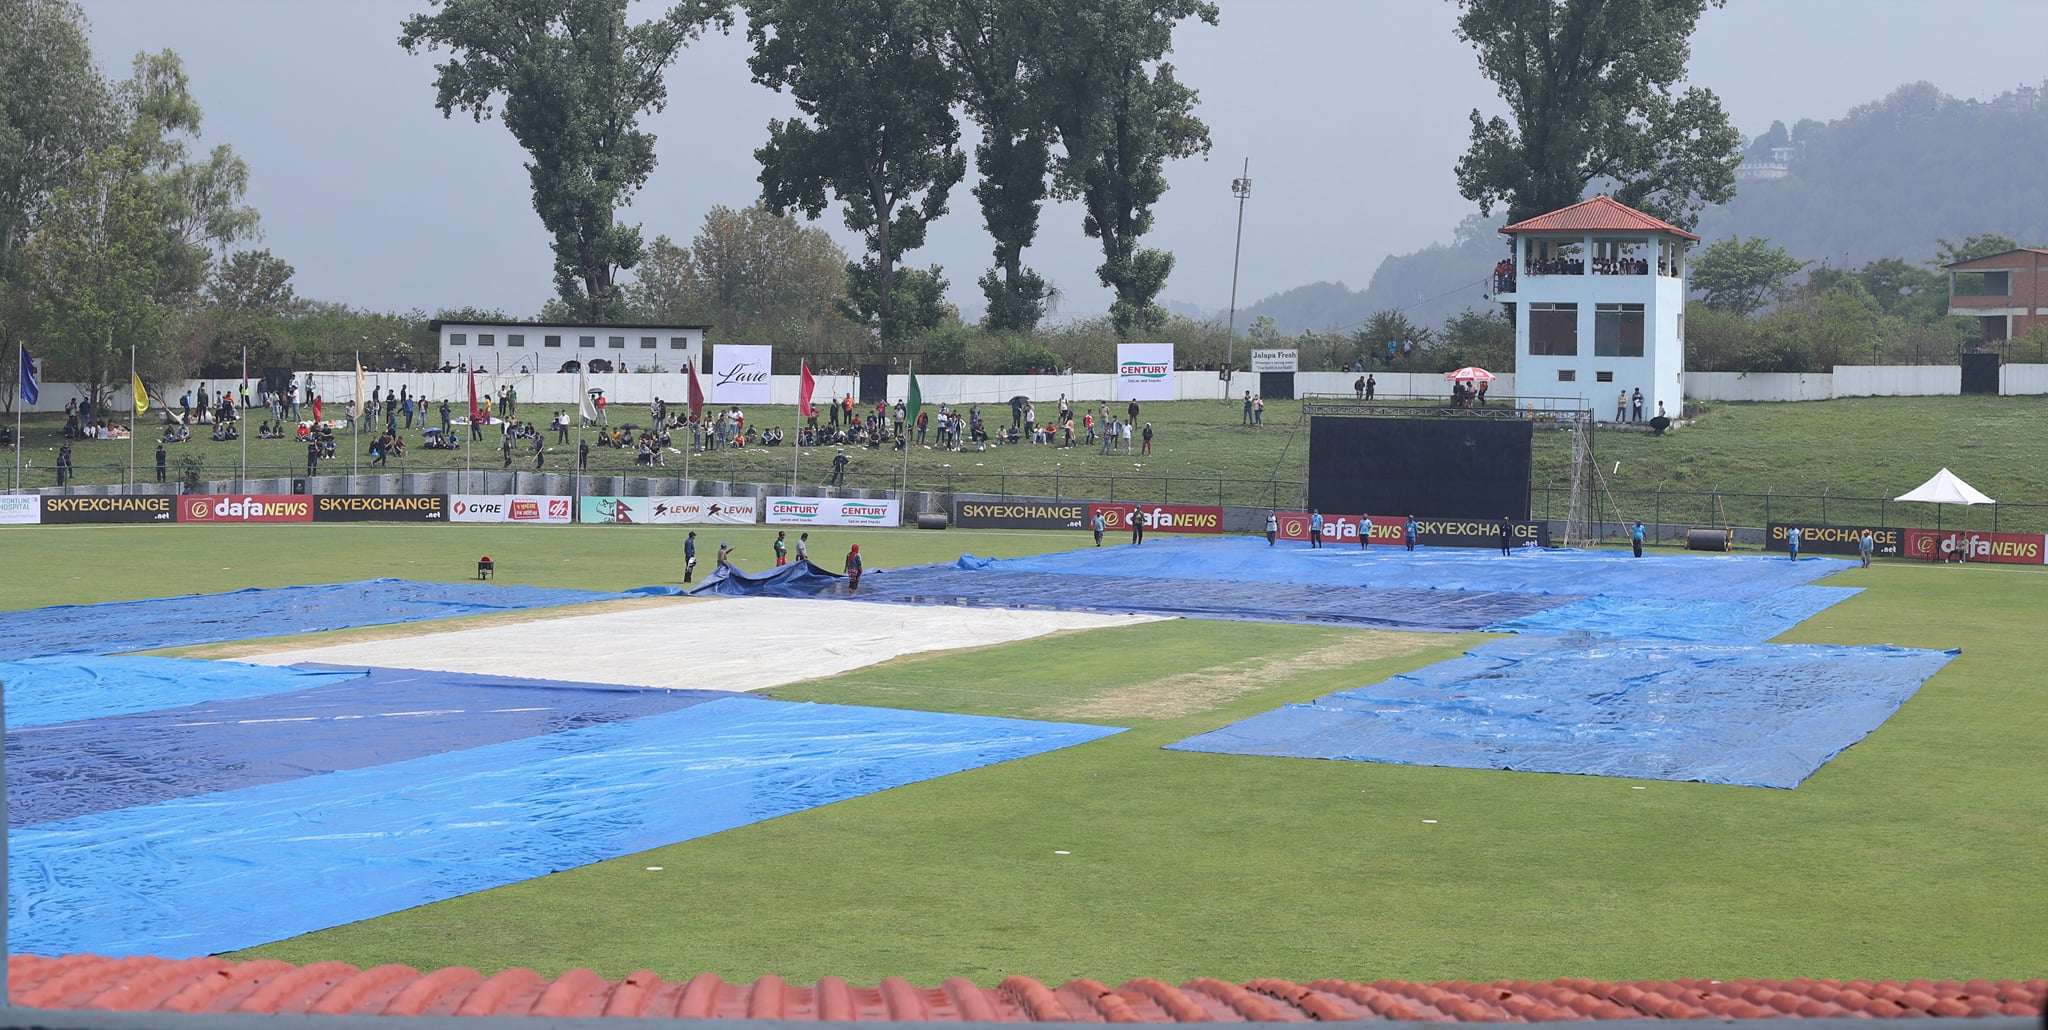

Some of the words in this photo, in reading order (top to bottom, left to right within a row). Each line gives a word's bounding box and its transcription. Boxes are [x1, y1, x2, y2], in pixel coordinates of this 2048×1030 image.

[1253, 352, 1276, 360] Jalapa
[1278, 351, 1296, 359] Fresh
[1121, 366, 1168, 374] CENTURY
[47, 498, 170, 511] SKYEXCHANGE
[319, 497, 441, 511] SKYEXCHANGE
[470, 504, 501, 513] GYRE
[670, 505, 700, 514] LEVIN
[724, 505, 753, 514] LEVIN
[773, 505, 819, 514] CENTURY
[841, 507, 887, 515] CENTURY
[963, 505, 1082, 519] SKYEXCHANGE
[1416, 521, 1538, 538] SKYEXCHAGE
[1940, 533, 2038, 558] dfaNEWS
